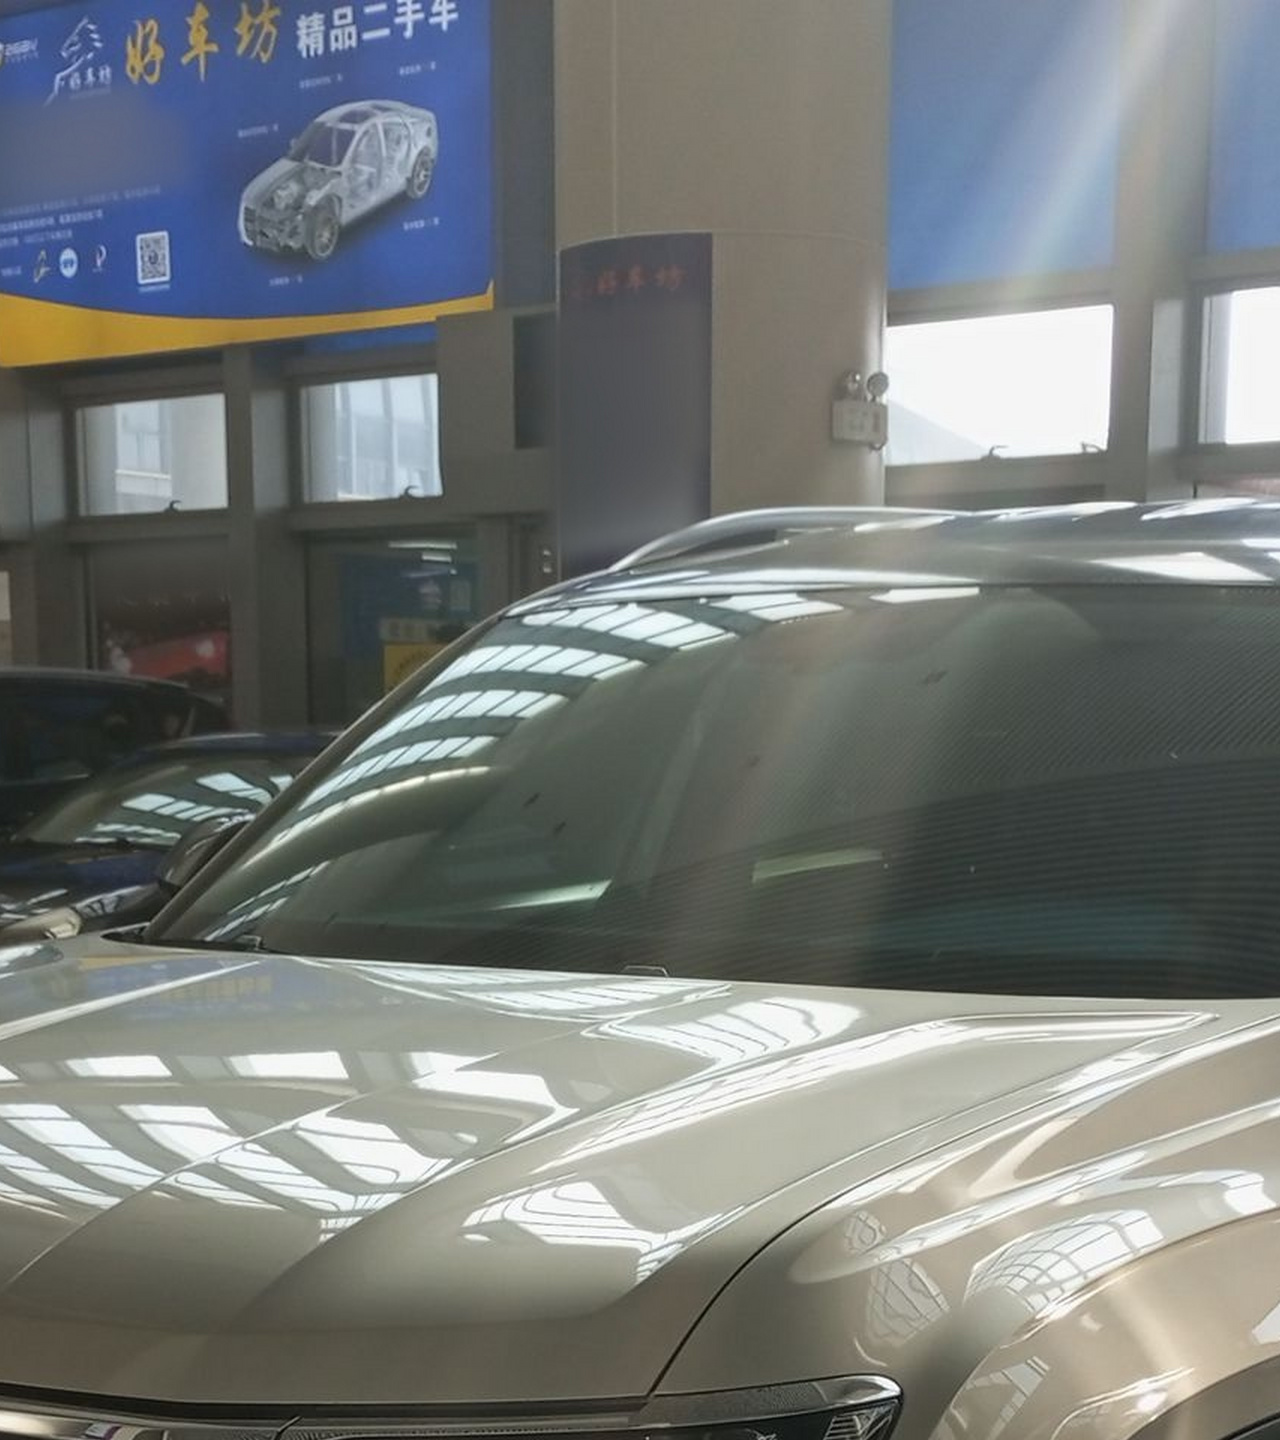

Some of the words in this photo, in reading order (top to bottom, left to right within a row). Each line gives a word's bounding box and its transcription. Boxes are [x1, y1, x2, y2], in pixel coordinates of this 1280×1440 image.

[126, 0, 281, 84] 好车坊
[296, 0, 459, 59] 精品二手车
